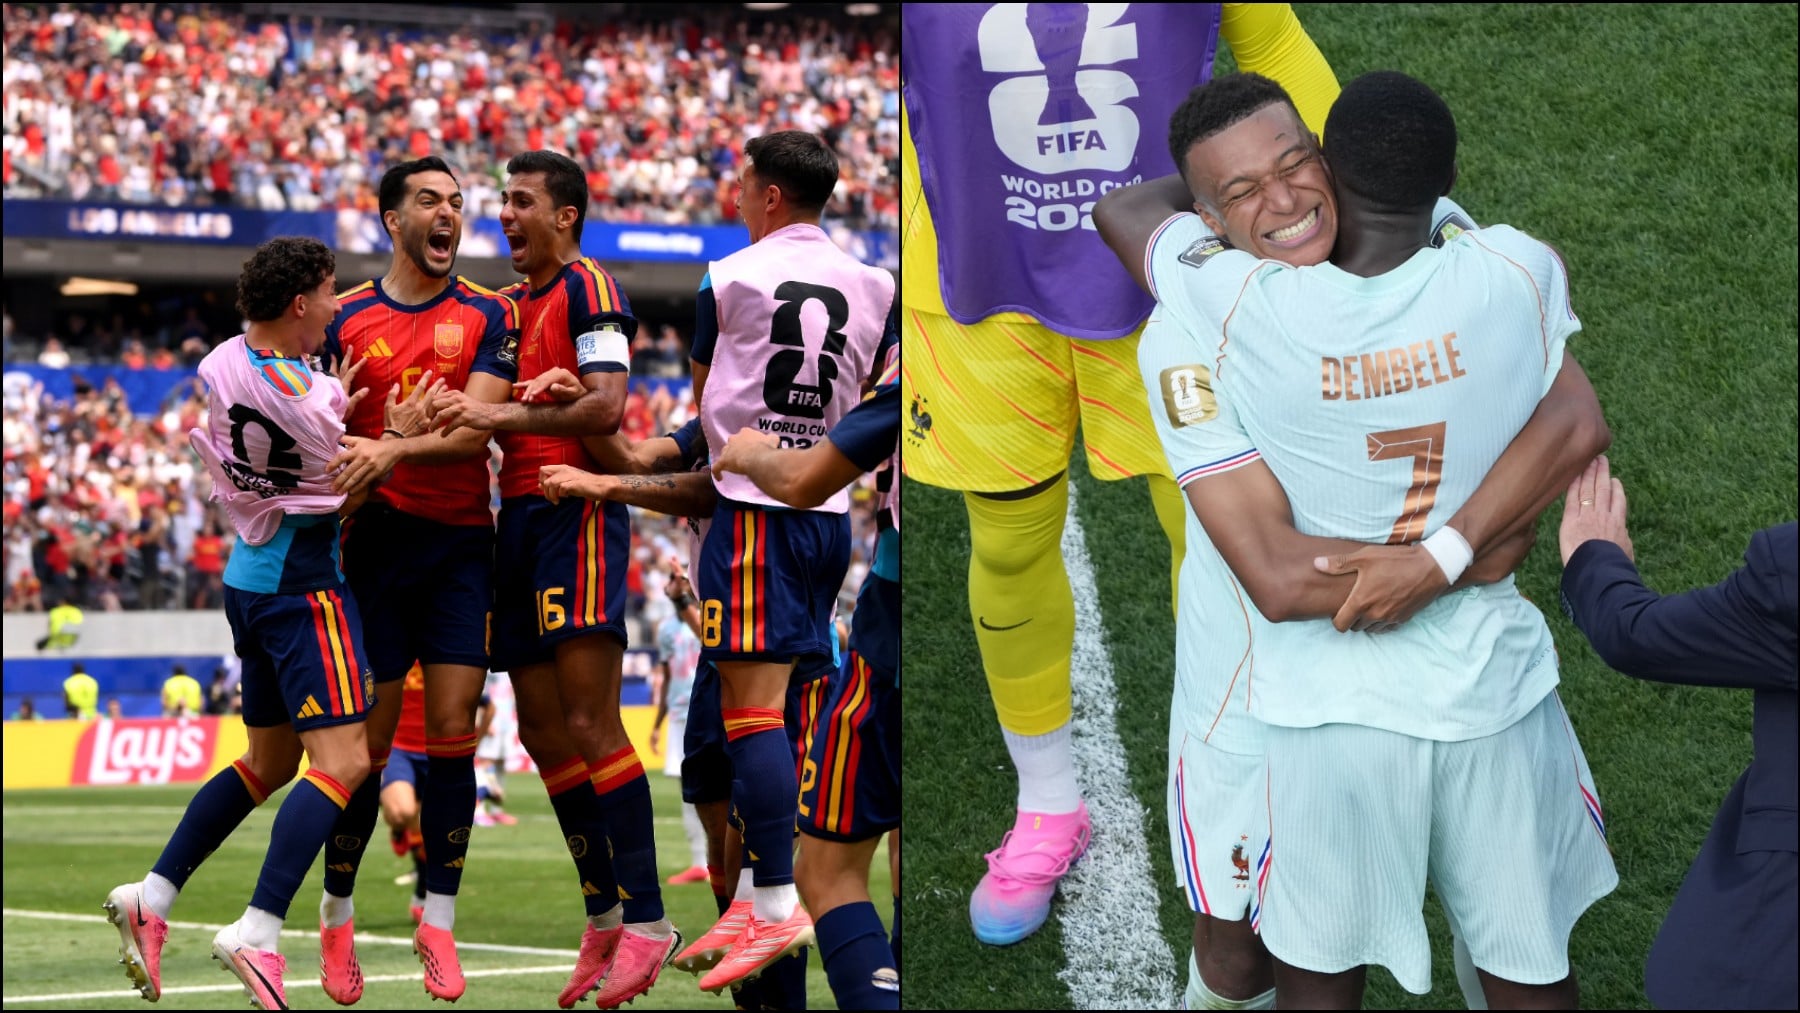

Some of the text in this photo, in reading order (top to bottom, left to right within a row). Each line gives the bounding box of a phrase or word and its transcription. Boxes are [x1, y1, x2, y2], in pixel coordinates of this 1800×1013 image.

[1037, 130, 1106, 155] FIFA
[1001, 174, 1095, 200] WORLD
[68, 208, 118, 233] LOS
[1004, 196, 1098, 231] 202
[1322, 332, 1466, 401] DEMBELE
[787, 390, 822, 408] FIFA
[758, 417, 827, 436] WORLD CU
[1366, 421, 1446, 545] 7
[536, 587, 566, 636] 16
[89, 718, 206, 785] Lay's
